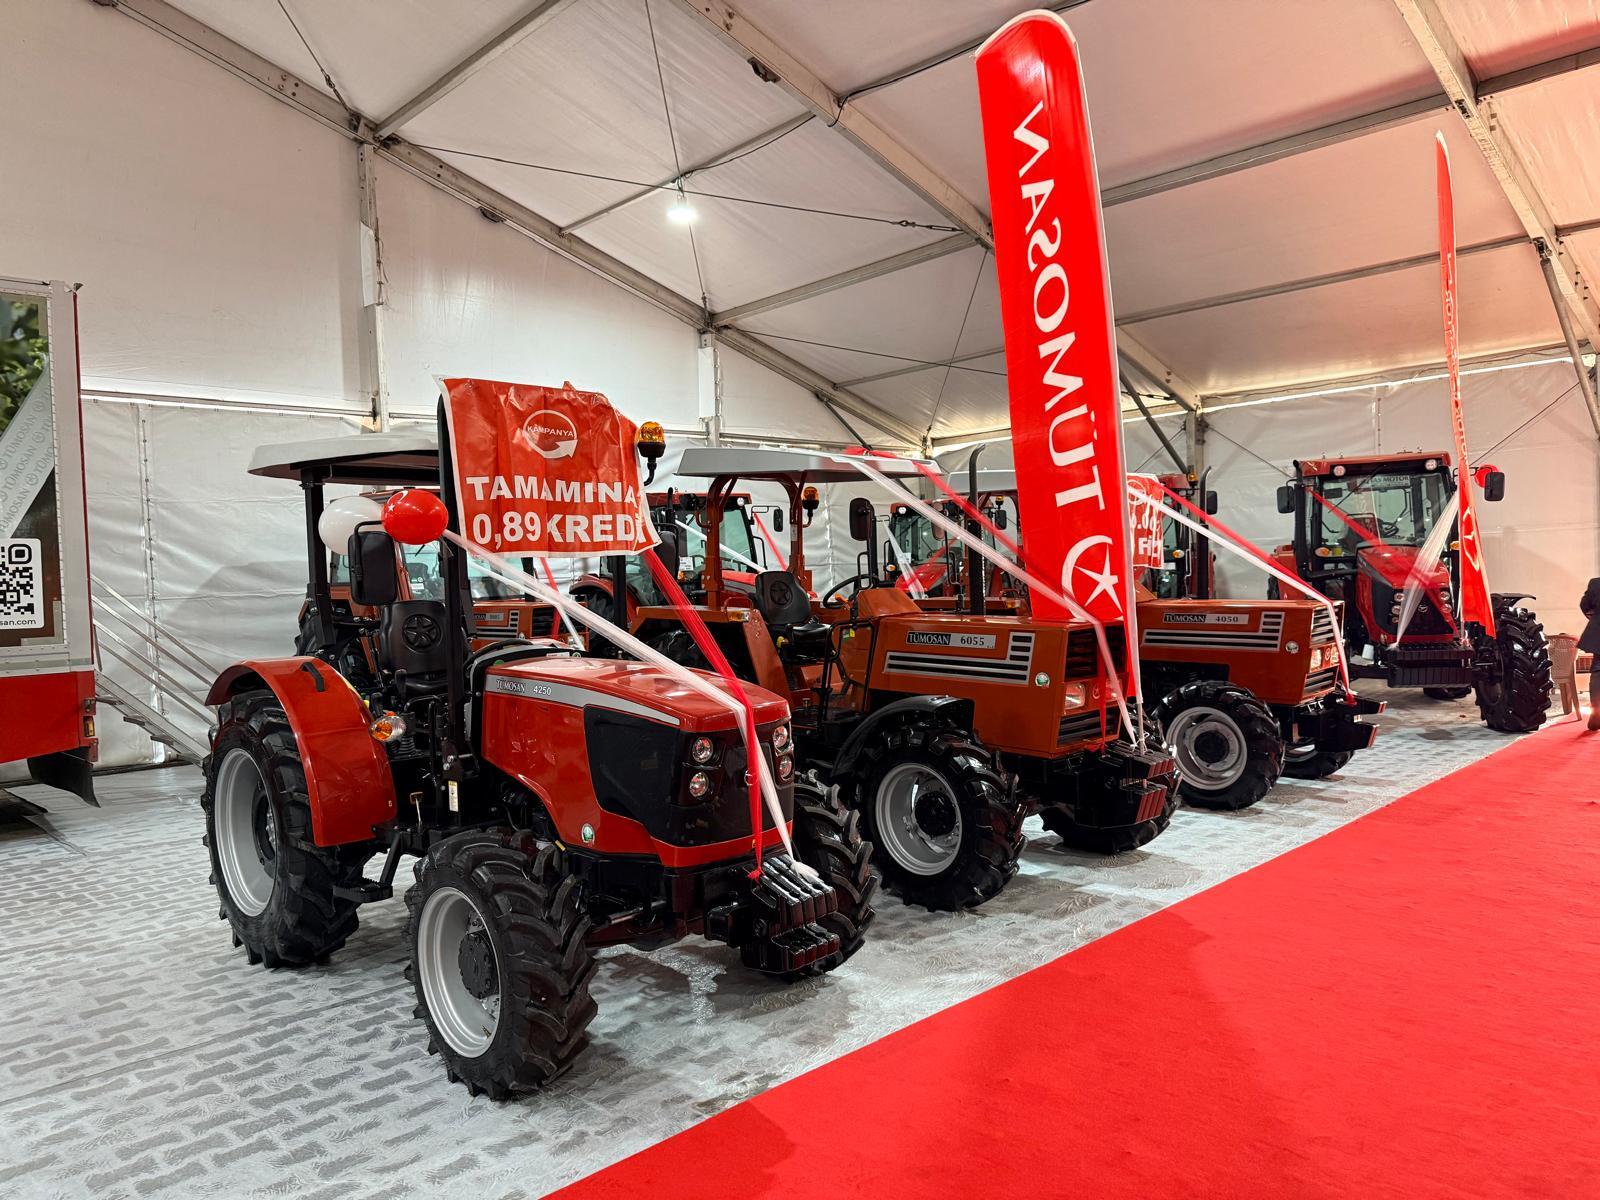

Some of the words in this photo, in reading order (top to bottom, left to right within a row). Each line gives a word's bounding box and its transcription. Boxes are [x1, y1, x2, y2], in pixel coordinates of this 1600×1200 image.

[472, 511, 542, 550] 0,89
[1214, 615, 1239, 623] 4050
[909, 632, 950, 645] TÜMOSAN
[960, 635, 985, 646] 6055
[533, 685, 552, 696] 4250
